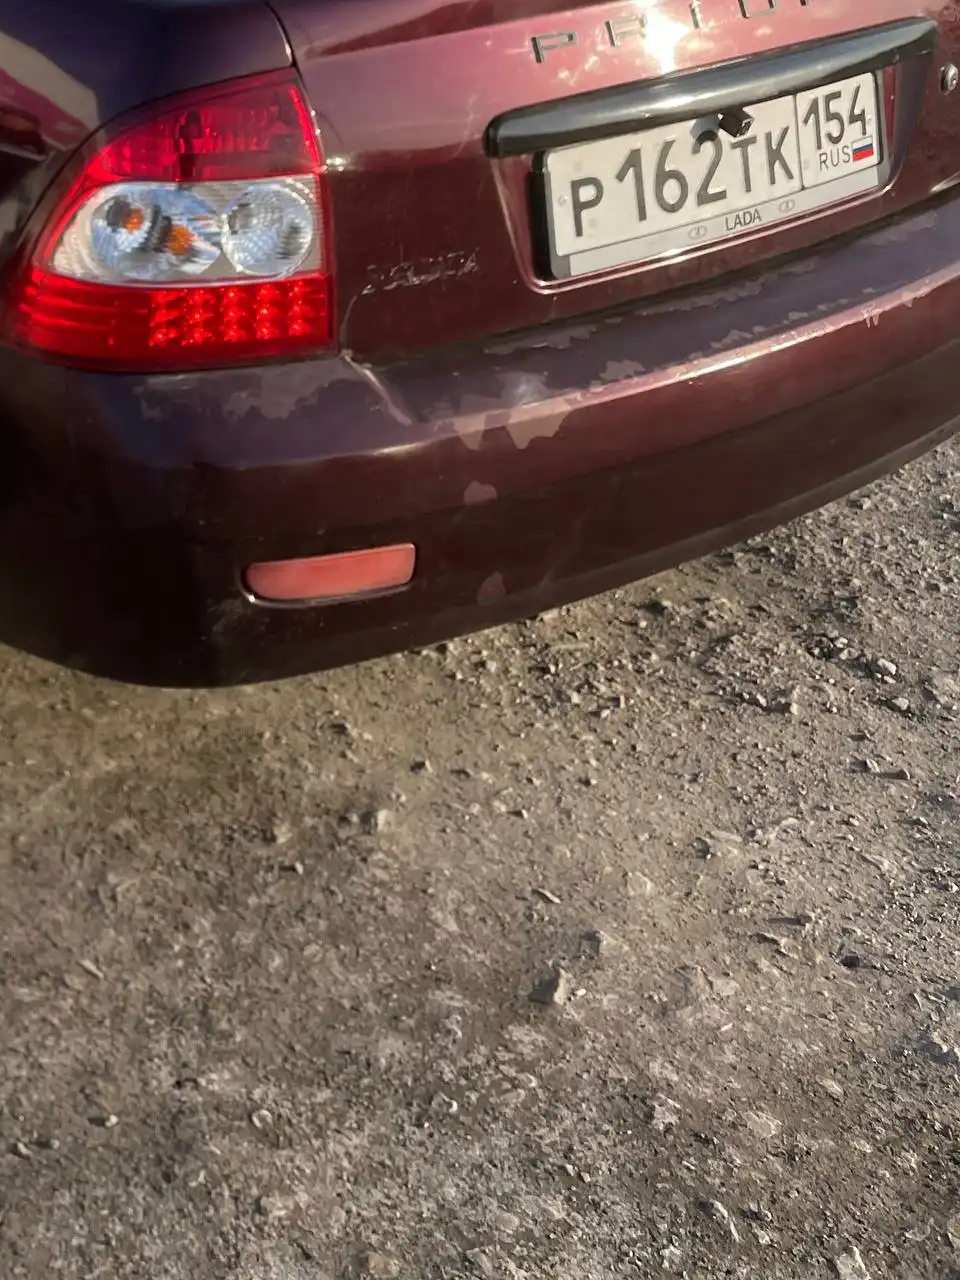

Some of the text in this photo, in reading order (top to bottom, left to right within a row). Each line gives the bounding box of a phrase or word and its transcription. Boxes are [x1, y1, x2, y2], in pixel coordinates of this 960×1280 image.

[802, 83, 869, 151] 154
[818, 146, 852, 172] RUS
[724, 207, 763, 232] LADA
